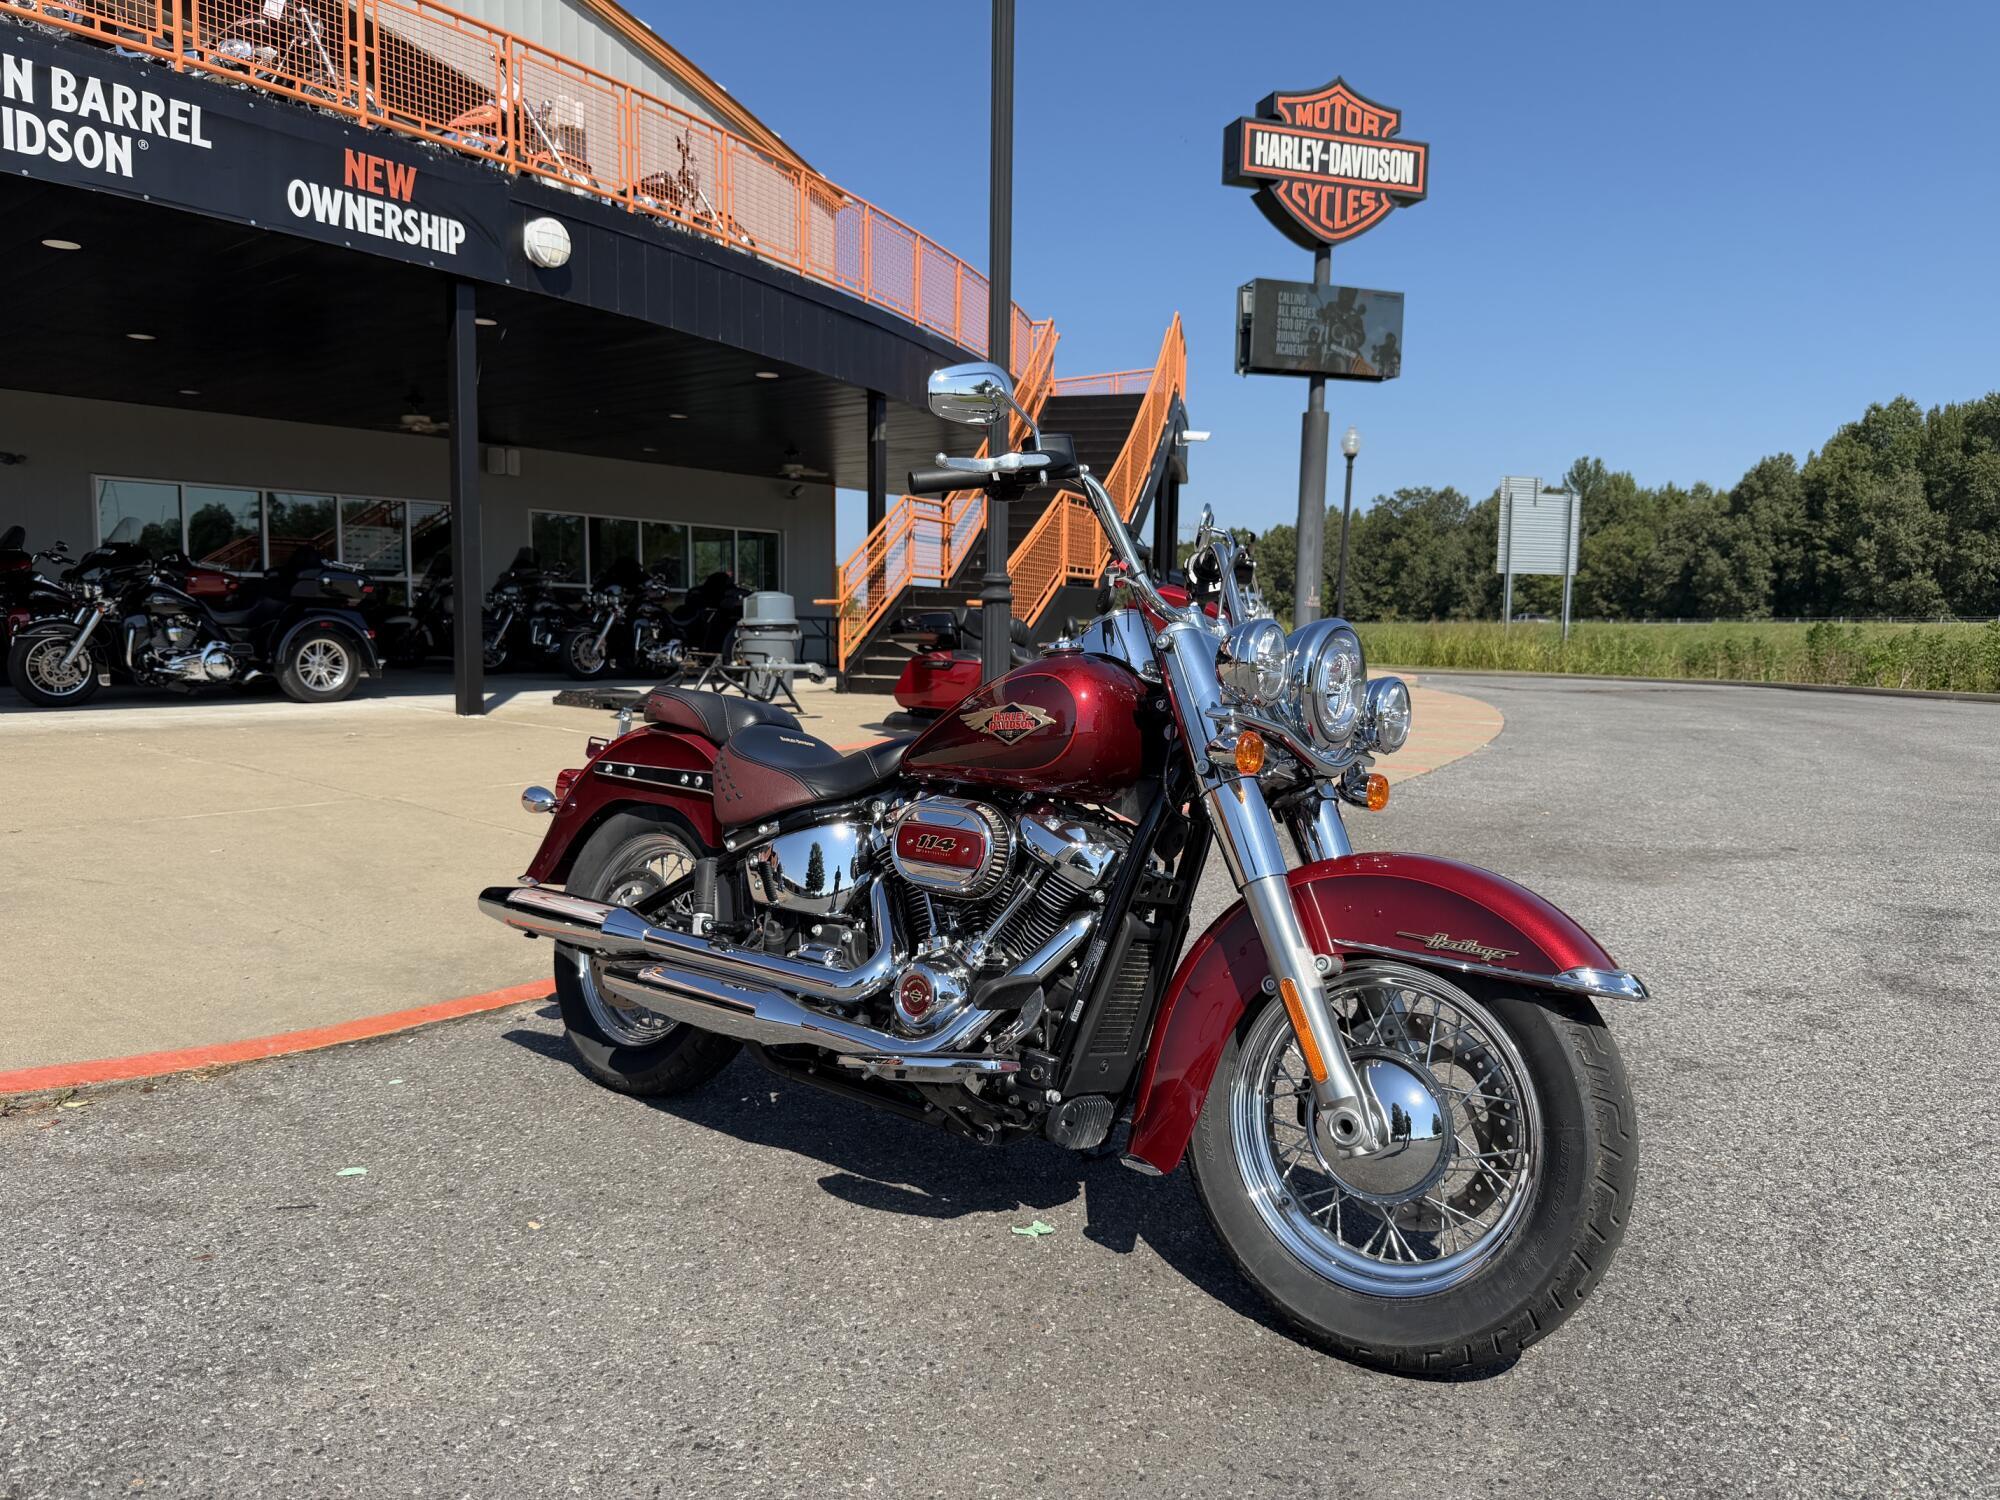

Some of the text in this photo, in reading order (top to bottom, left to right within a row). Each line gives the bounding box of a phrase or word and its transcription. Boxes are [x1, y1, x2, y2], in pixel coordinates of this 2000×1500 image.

[50, 65, 212, 150] BARREL
[1295, 94, 1379, 137] MOTOR
[1255, 130, 1414, 185] HARLEY-DAVIDSON
[343, 148, 417, 202] NEW
[287, 179, 466, 255] OWNERSHIP
[1292, 181, 1376, 230] CYCLES
[1278, 305, 1289, 317] ALL
[1279, 292, 1307, 305] CALLING
[1276, 331, 1300, 343] RIDING
[1294, 319, 1308, 331] OFF
[988, 720, 1034, 733] DAVIDSON
[916, 834, 957, 851] 114
[1425, 932, 1507, 961] Heritage
